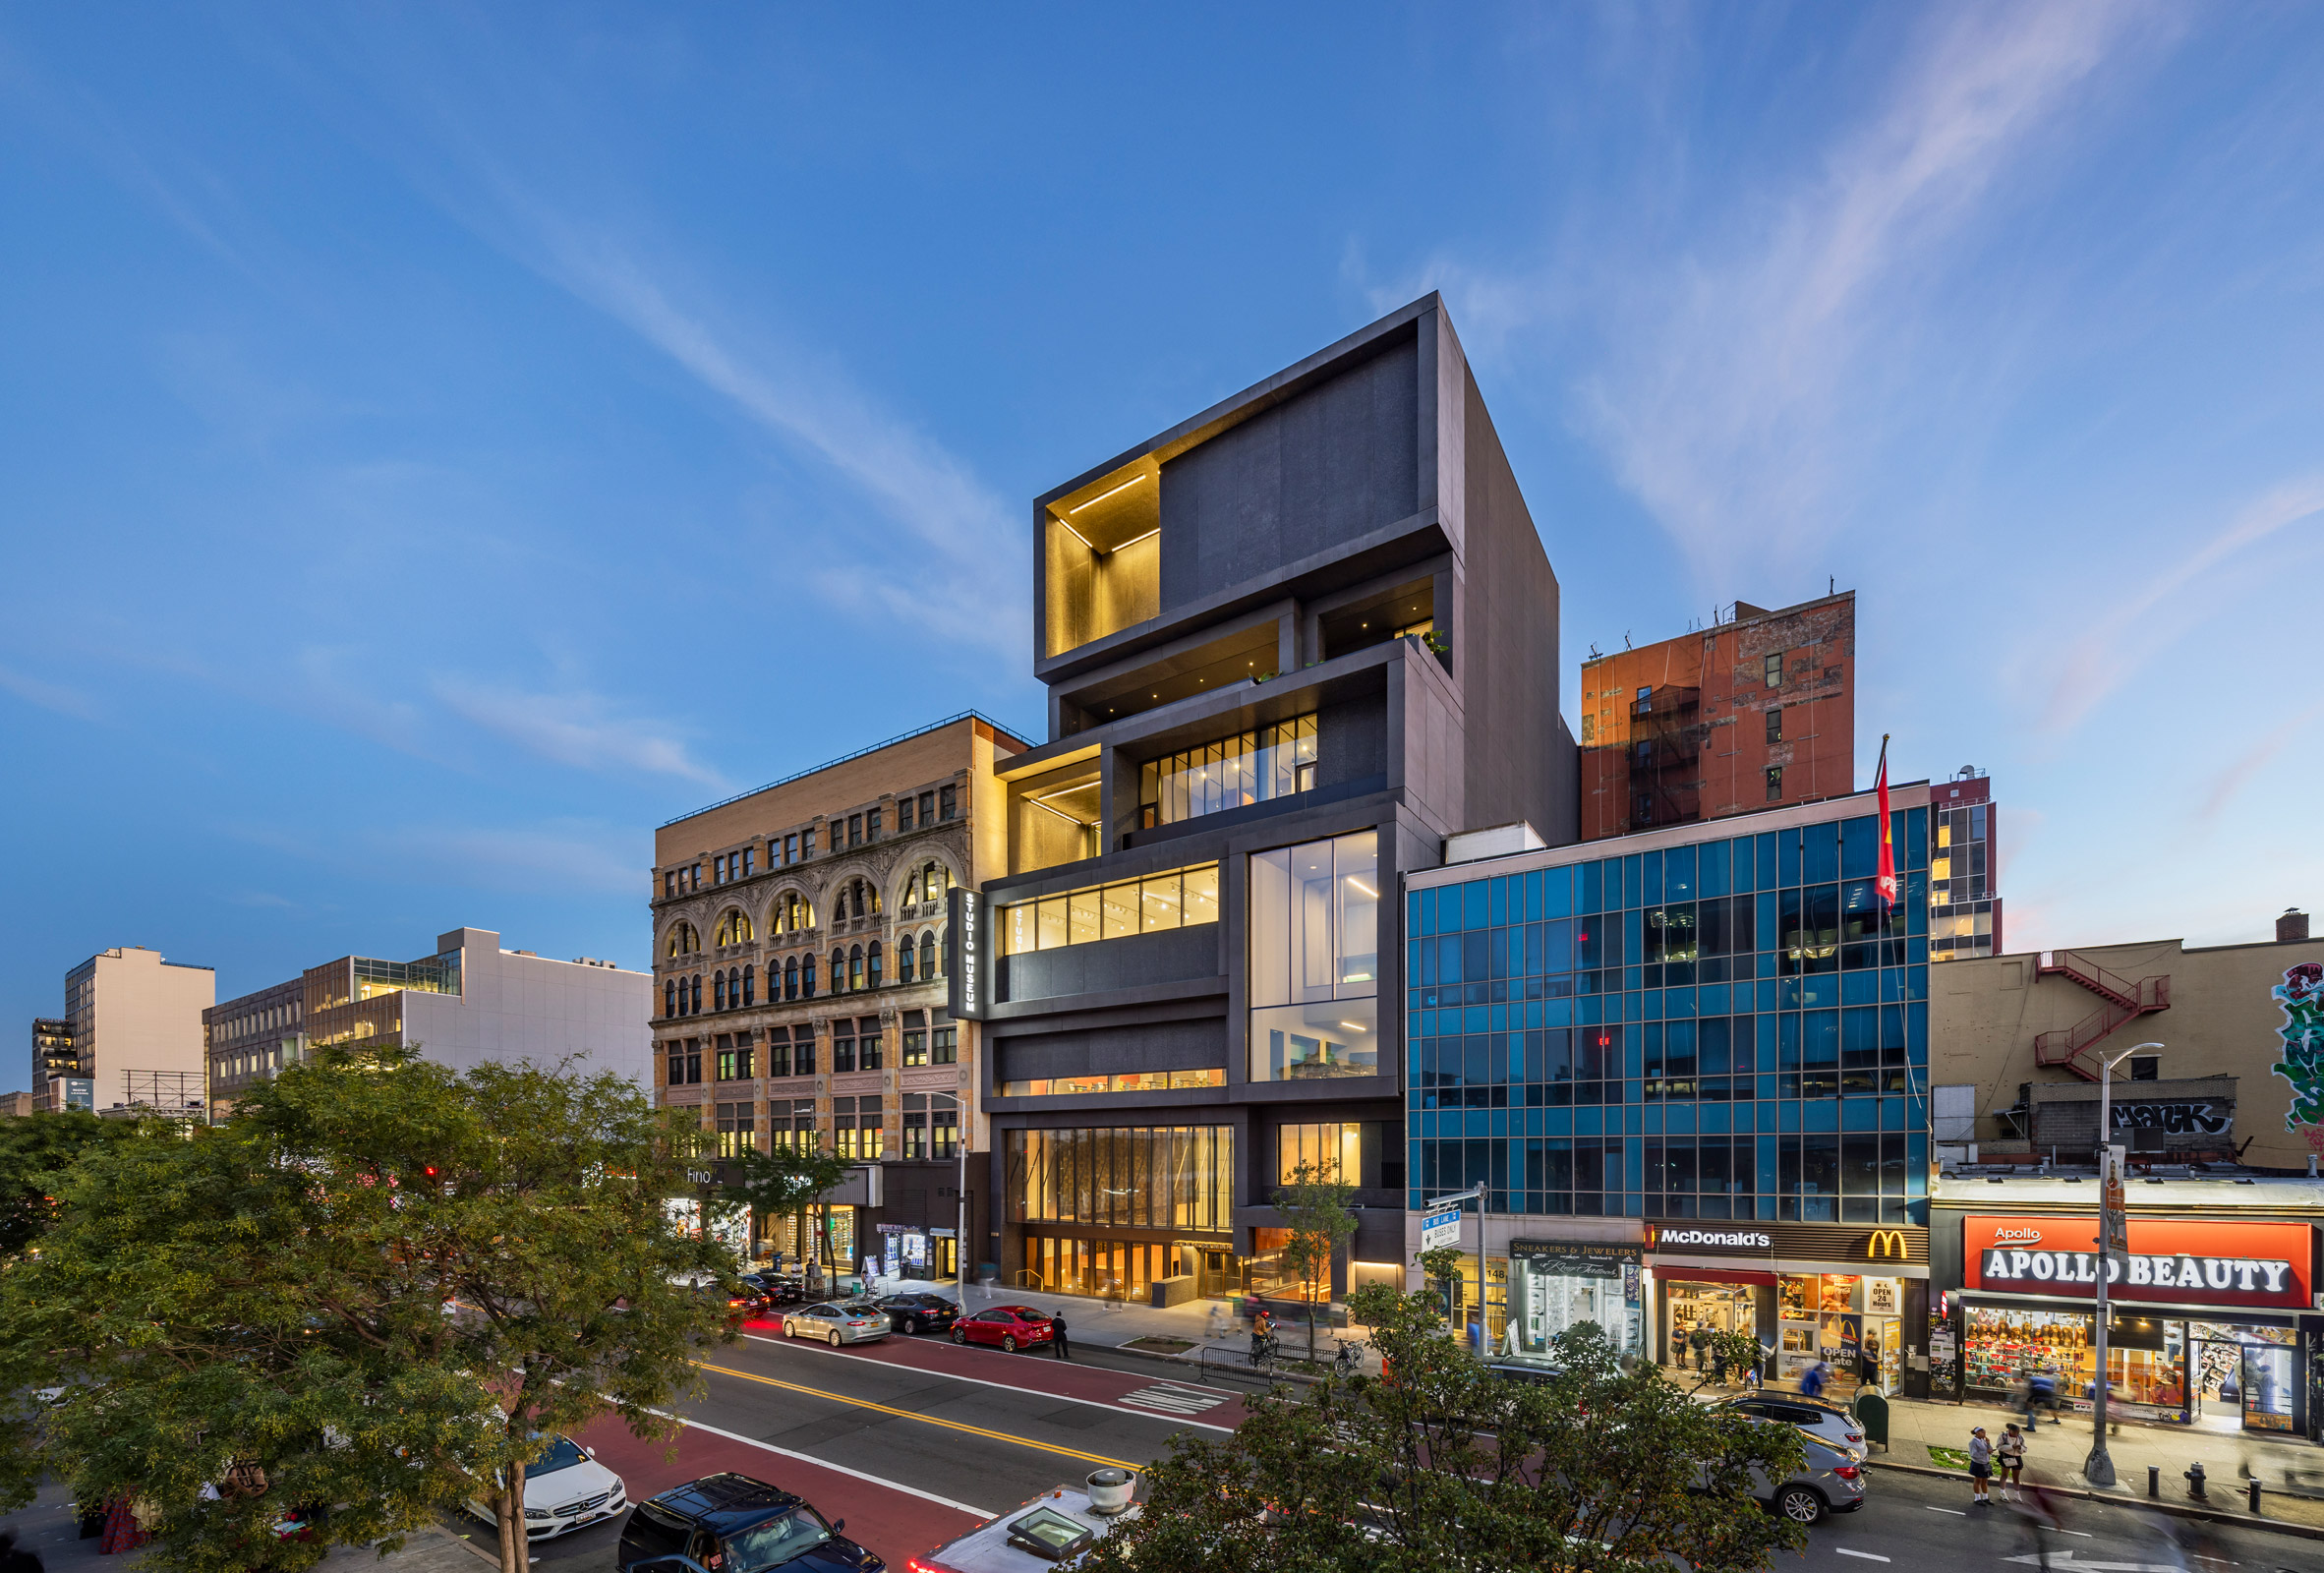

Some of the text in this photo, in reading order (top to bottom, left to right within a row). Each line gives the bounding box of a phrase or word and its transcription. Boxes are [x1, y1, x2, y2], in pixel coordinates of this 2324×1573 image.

[965, 893, 975, 1012] STUDIO MUSEUM
[1440, 1214, 1449, 1223] LANE
[1434, 1224, 1456, 1239] BUSES ONLY
[1661, 1229, 1770, 1247] McDonald's
[1995, 1227, 2041, 1240] Apollo
[1514, 1243, 1567, 1253] SNEAKERS
[1582, 1245, 1637, 1256] JEWELERS
[1486, 1269, 1505, 1279] 148
[1985, 1250, 2289, 1292] APOLLO BEAUTY
[1836, 1335, 1856, 1345] DELIVERY
[1823, 1347, 1856, 1358] OPEN
[1829, 1356, 1853, 1367] Late
